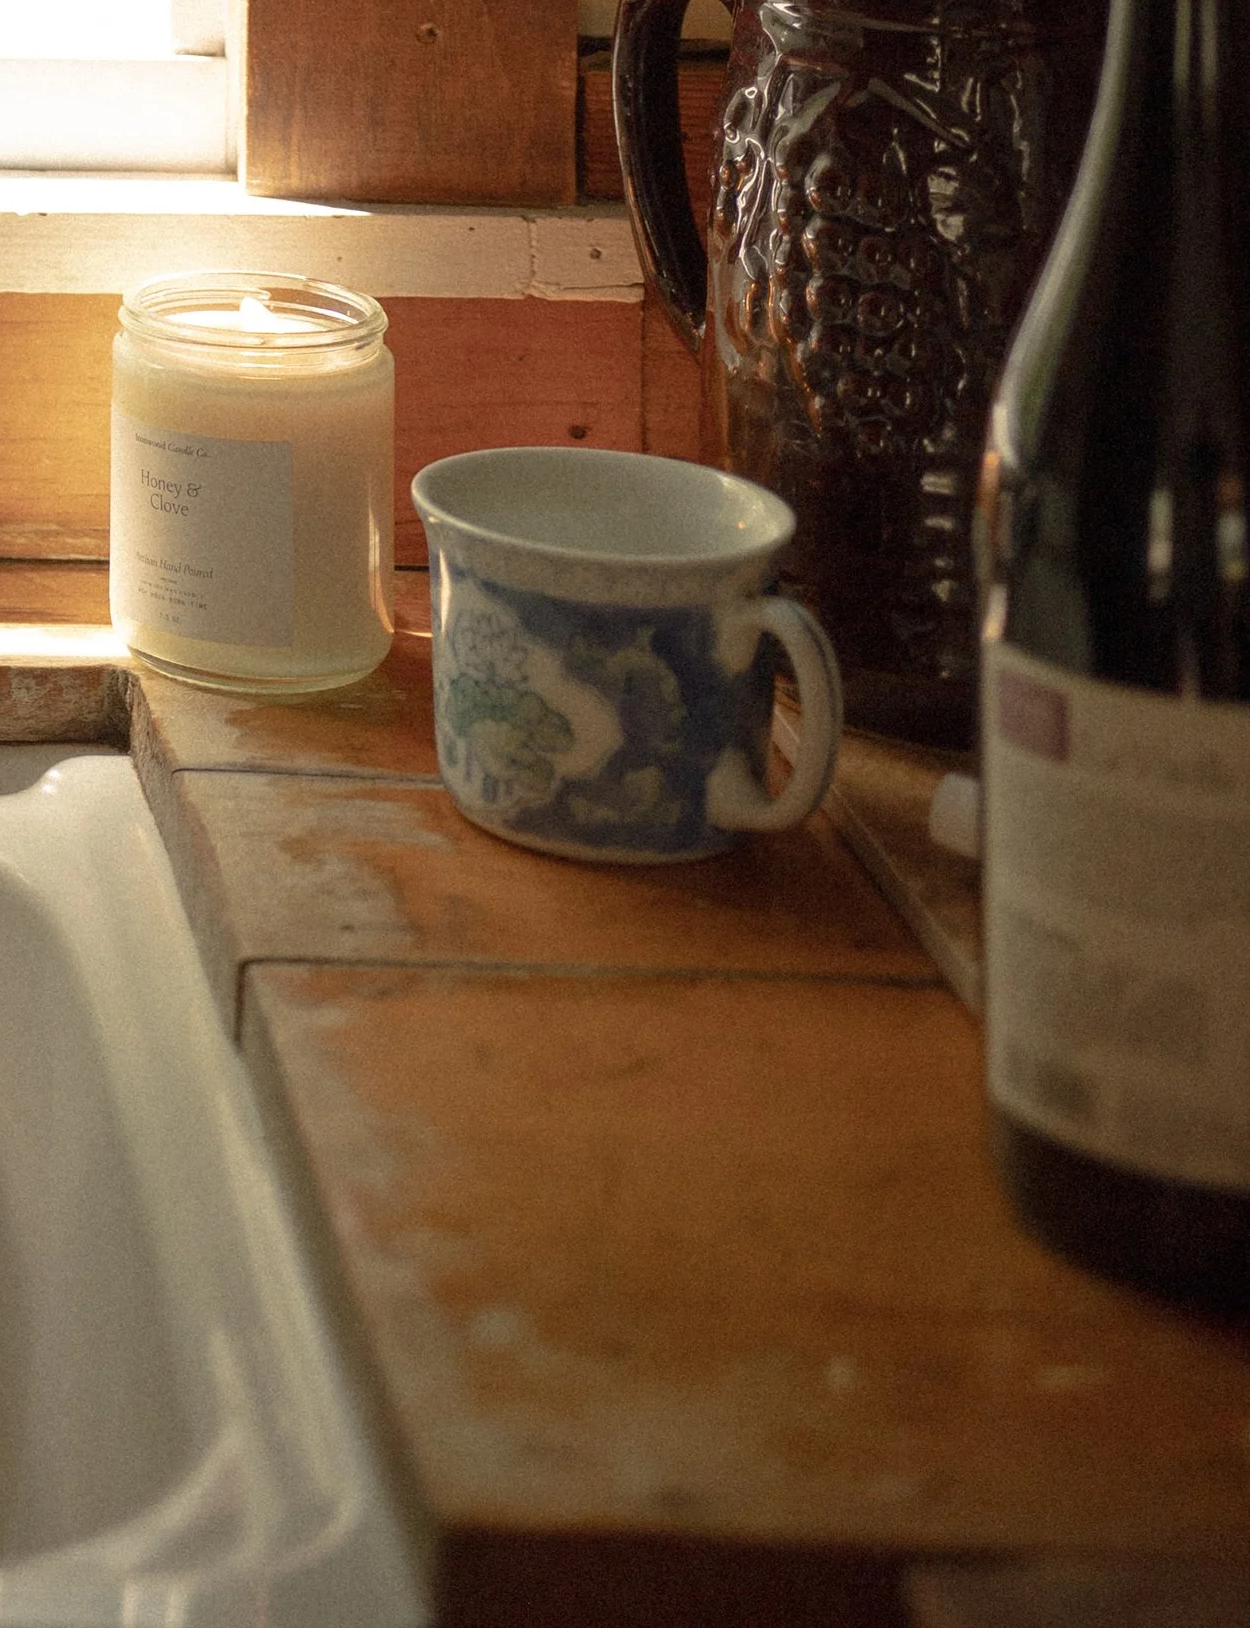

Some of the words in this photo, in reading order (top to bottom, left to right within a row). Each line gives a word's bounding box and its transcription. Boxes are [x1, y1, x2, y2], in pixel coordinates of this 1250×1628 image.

[168, 443, 194, 456] Candle
[141, 469, 182, 499] Honey
[186, 483, 202, 498] &
[150, 493, 189, 517] Clove
[160, 559, 182, 573] Hand
